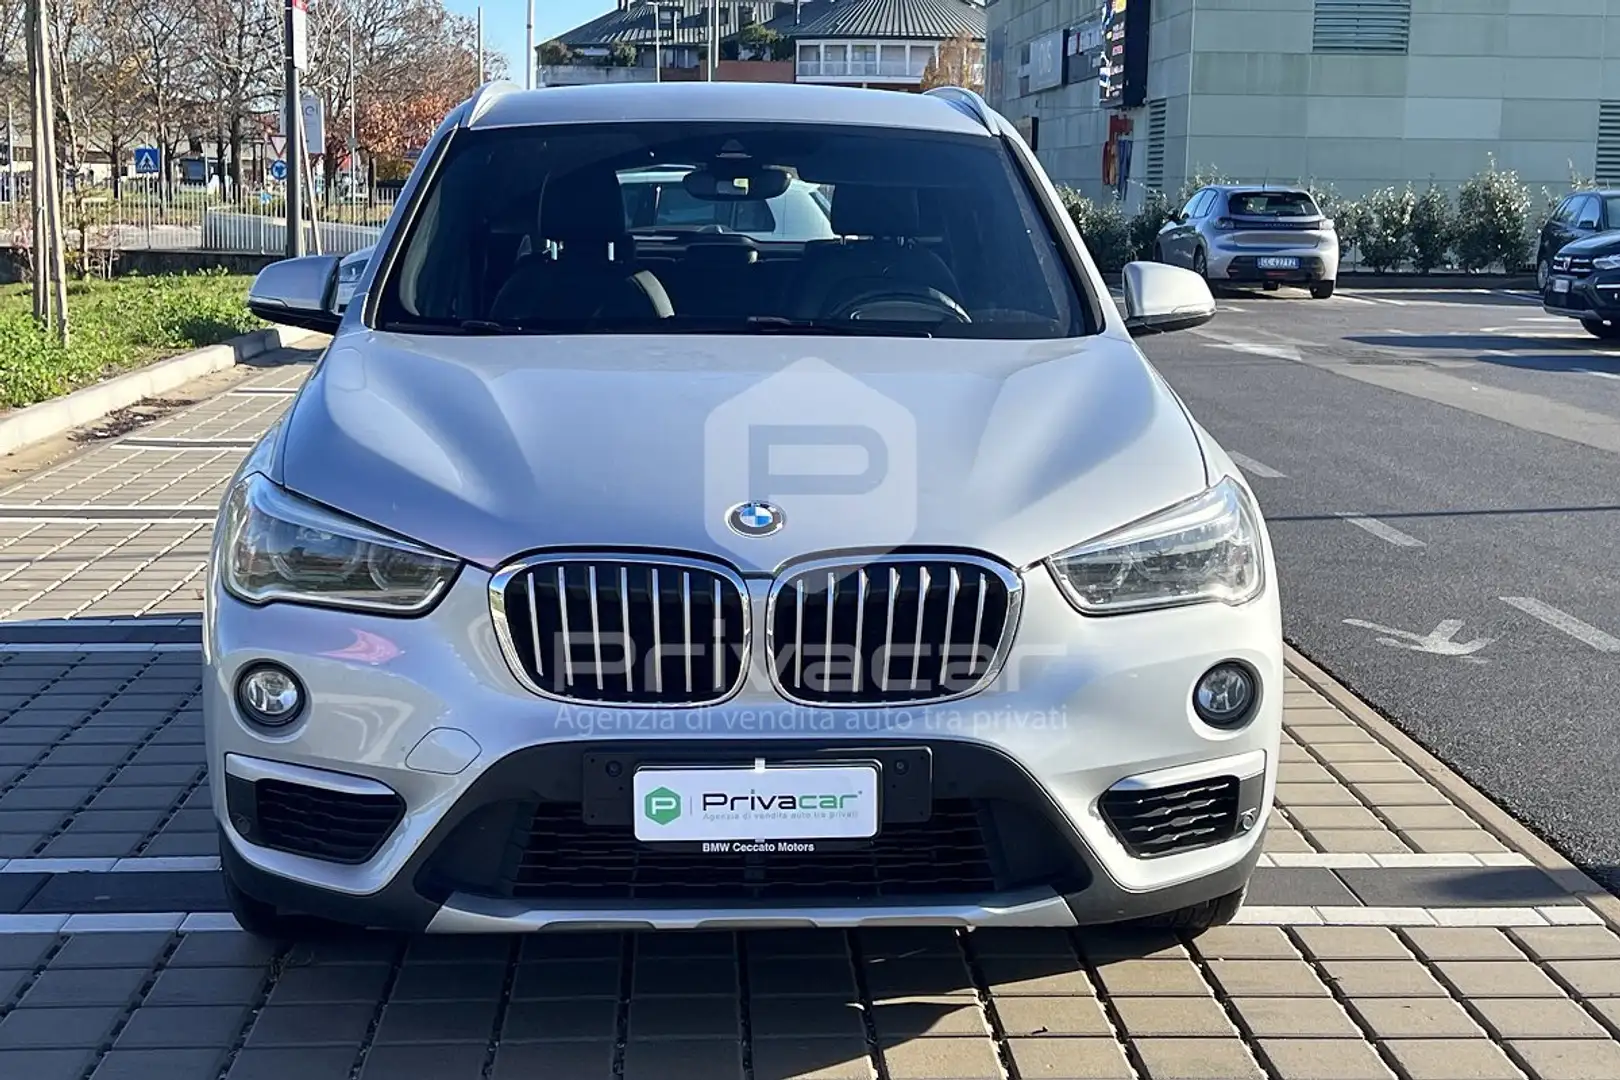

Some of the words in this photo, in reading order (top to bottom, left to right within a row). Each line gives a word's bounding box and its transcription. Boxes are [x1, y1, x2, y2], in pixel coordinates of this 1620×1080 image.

[703, 789, 858, 811] Privacar
[702, 812, 740, 821] Agenzia
[742, 811, 752, 820] di
[754, 811, 788, 820] vendita
[790, 811, 812, 819] auto
[814, 810, 827, 819] tra
[828, 810, 859, 820] privati
[702, 842, 730, 852] BMW
[732, 842, 775, 852] Ceccato
[778, 842, 815, 852] Motors
